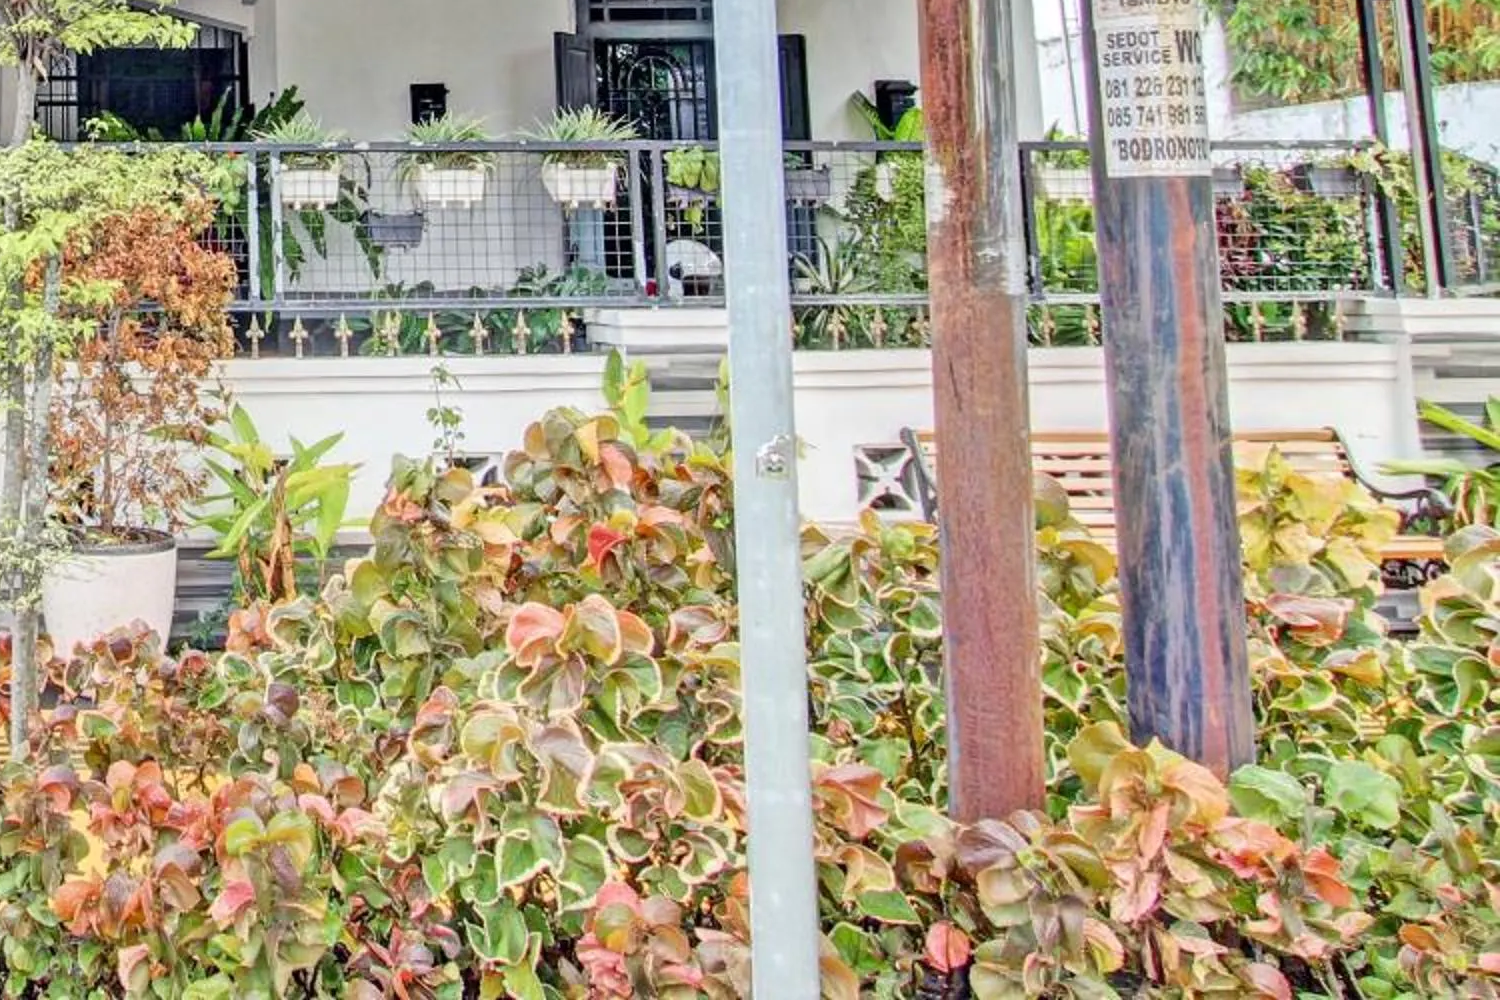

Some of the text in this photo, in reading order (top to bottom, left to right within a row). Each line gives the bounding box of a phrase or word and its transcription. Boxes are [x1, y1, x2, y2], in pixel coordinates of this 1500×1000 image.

[1107, 30, 1159, 49] SEDOT
[1103, 49, 1171, 67] SERVICE
[1106, 78, 1128, 99] 081
[1107, 106, 1132, 127] 085
